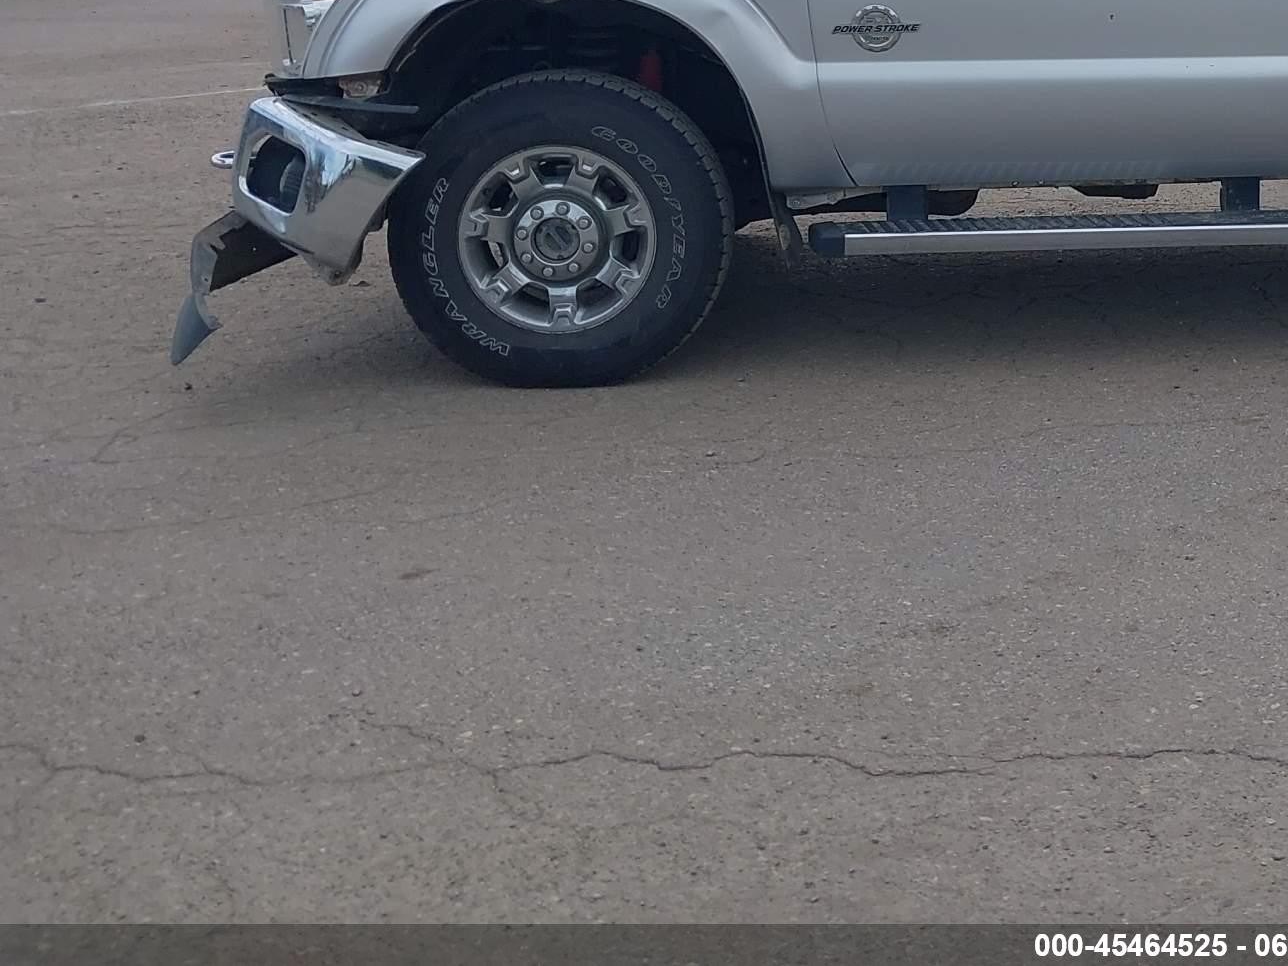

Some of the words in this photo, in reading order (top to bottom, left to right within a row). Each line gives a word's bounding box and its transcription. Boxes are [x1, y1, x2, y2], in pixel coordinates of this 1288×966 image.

[832, 25, 873, 34] POWER
[873, 24, 921, 33] STROKE
[417, 177, 511, 357] WRANGLER
[590, 125, 687, 310] GOODYEAR
